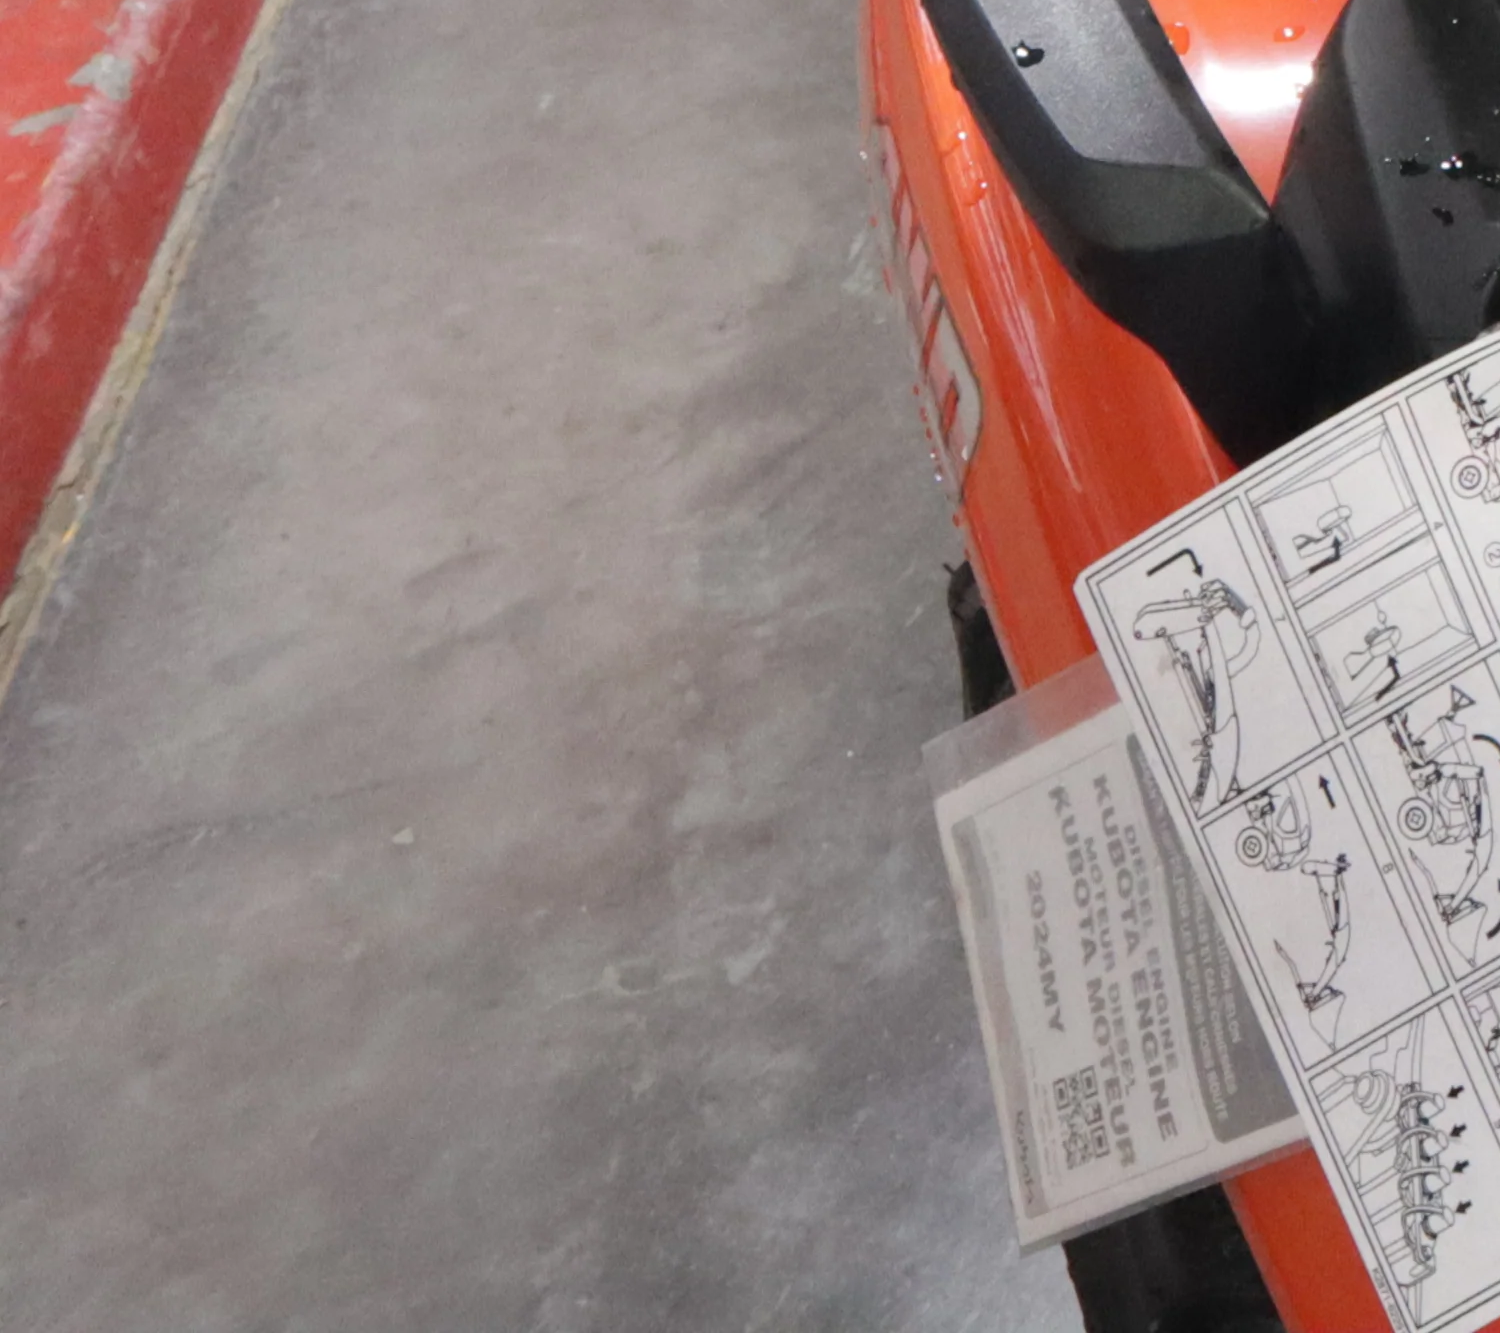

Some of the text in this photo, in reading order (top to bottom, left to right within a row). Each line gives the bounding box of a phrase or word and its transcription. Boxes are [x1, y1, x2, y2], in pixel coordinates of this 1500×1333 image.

[1023, 868, 1064, 1036] 2024MY
[1047, 784, 1136, 1169] KUBOTA MOTEUR
[1082, 835, 1138, 1097] MOTEUR DIESEL
[1091, 773, 1178, 1142] KUBOTA ENGINE
[1123, 824, 1178, 1073] DIESEL ENGINE
